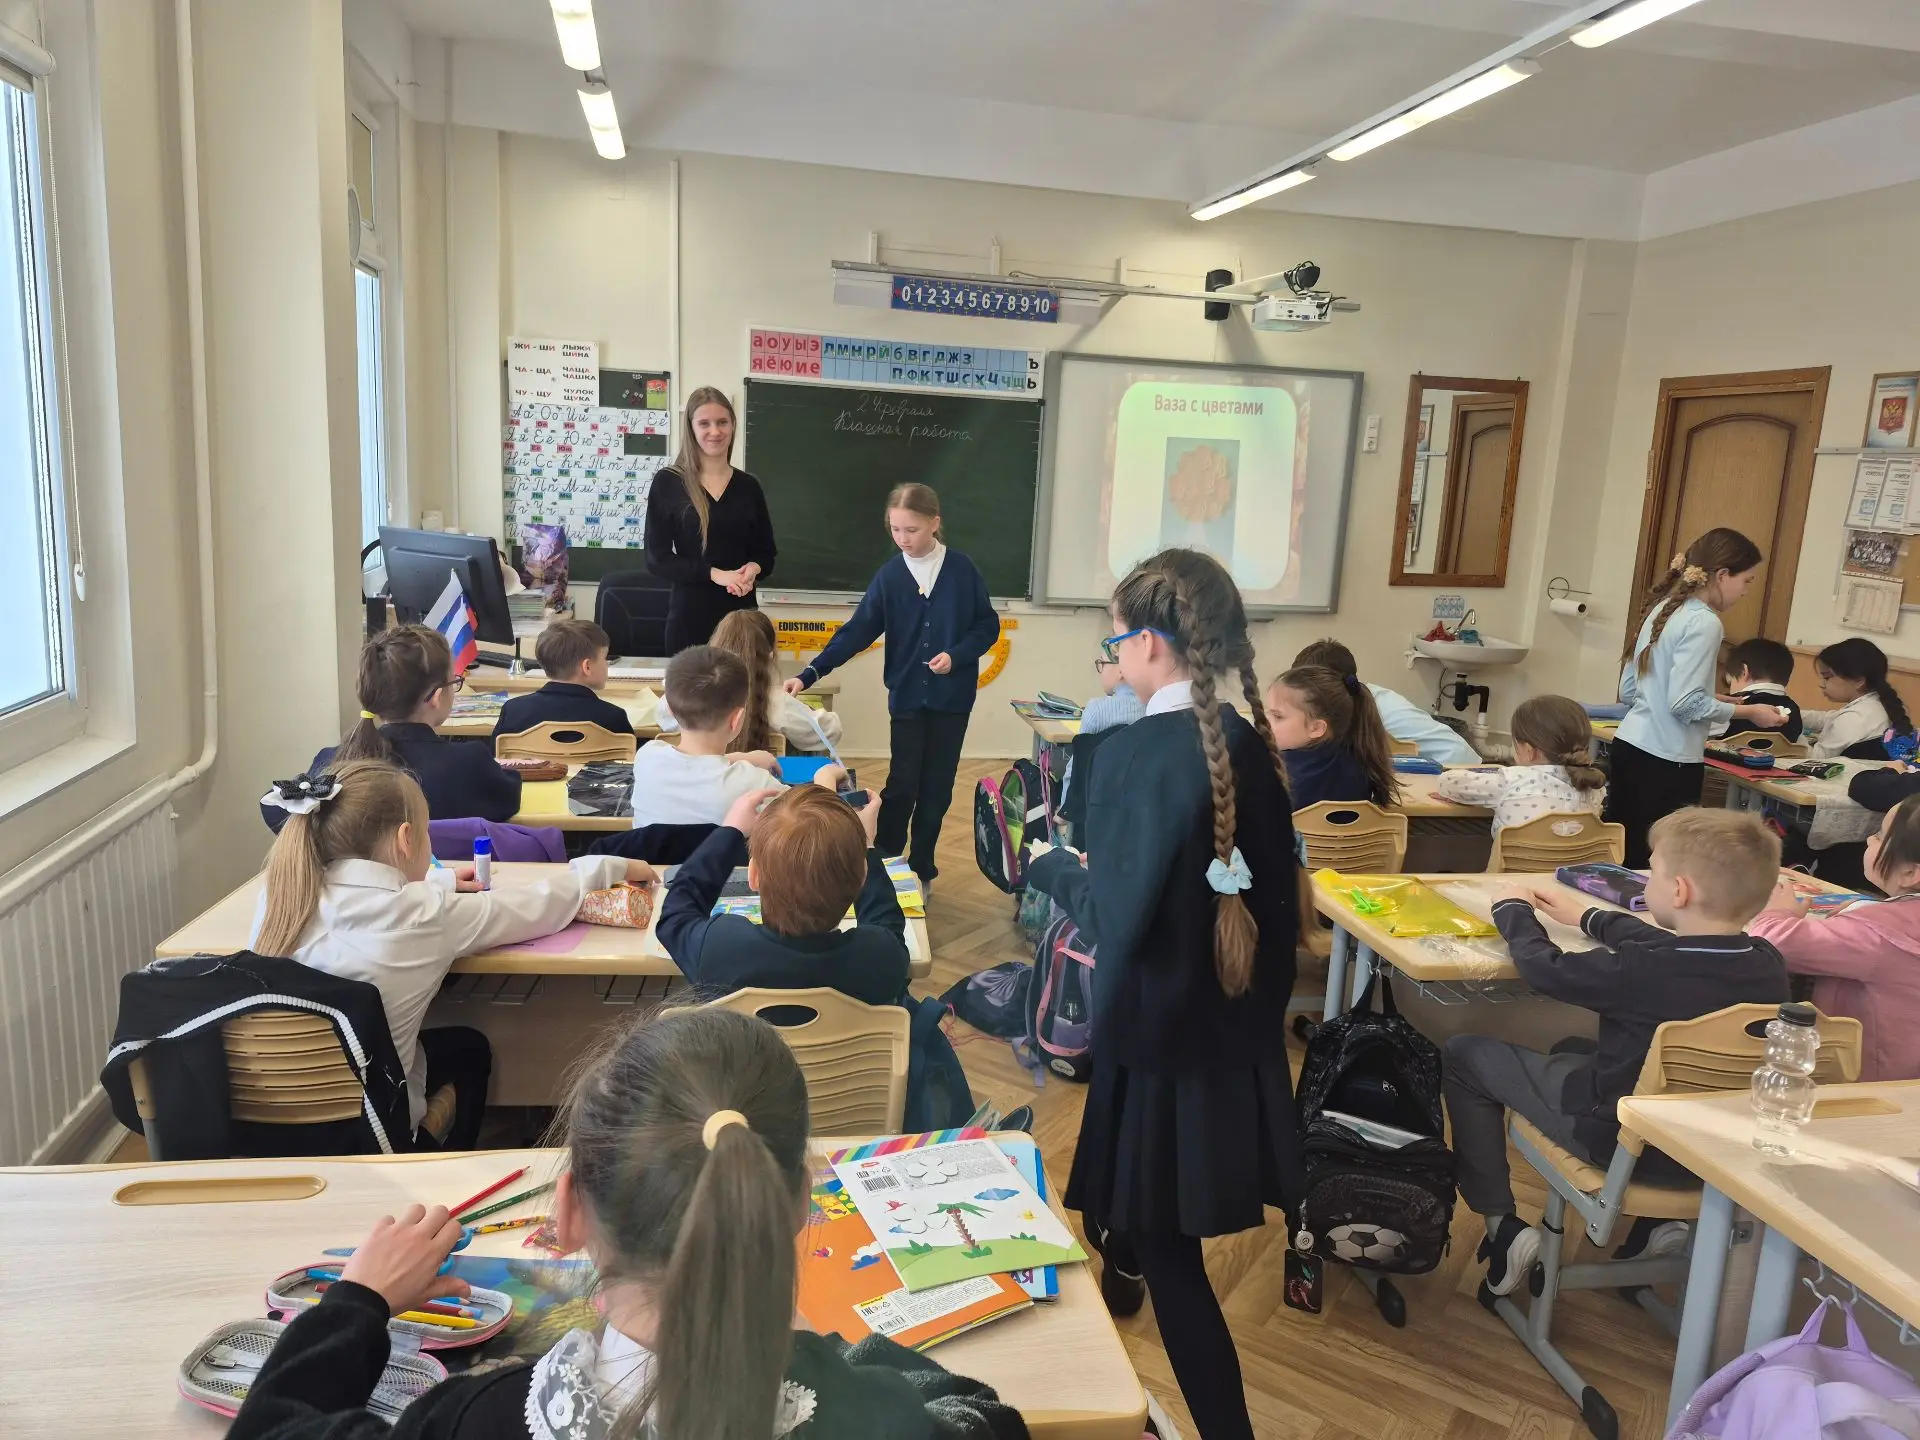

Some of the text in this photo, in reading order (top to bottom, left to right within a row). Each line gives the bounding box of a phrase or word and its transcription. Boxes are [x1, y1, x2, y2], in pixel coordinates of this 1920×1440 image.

[514, 342, 530, 350] ЖИ
[539, 344, 555, 352] ШИ
[536, 367, 552, 375] ЩА
[562, 366, 590, 374] ЧАЩА
[562, 373, 597, 381] ЧАШКА
[536, 390, 552, 398] ЩУ
[563, 388, 594, 396] ЧУЛОК
[1154, 394, 1264, 416] Ваза с цветами
[907, 423, 974, 447] работа
[778, 622, 826, 632] EDUSTRONG
